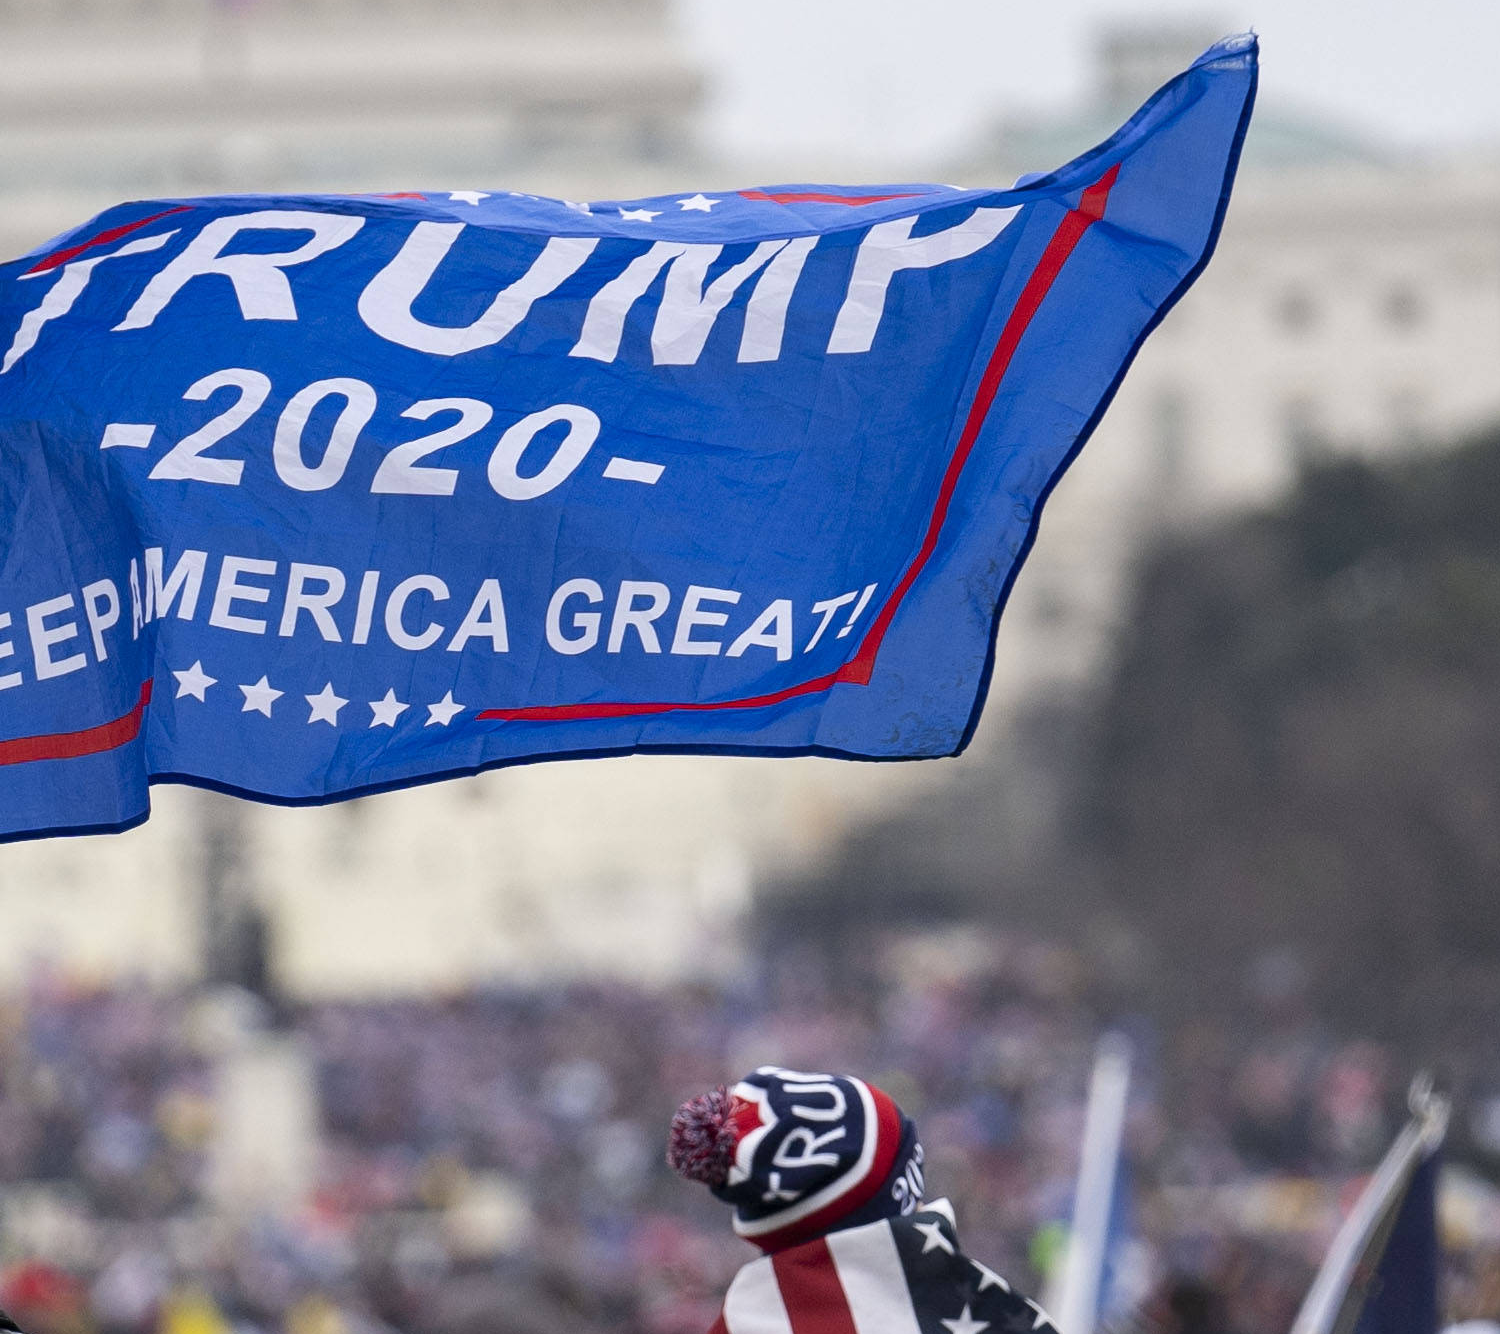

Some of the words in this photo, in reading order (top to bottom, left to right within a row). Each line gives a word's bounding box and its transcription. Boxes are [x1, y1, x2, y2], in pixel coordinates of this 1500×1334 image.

[0, 203, 1025, 375] TRUMP
[100, 368, 667, 501] -2020-
[130, 547, 511, 655] AMERICA
[544, 578, 878, 662] GREAT!
[757, 1066, 847, 1202] TRU
